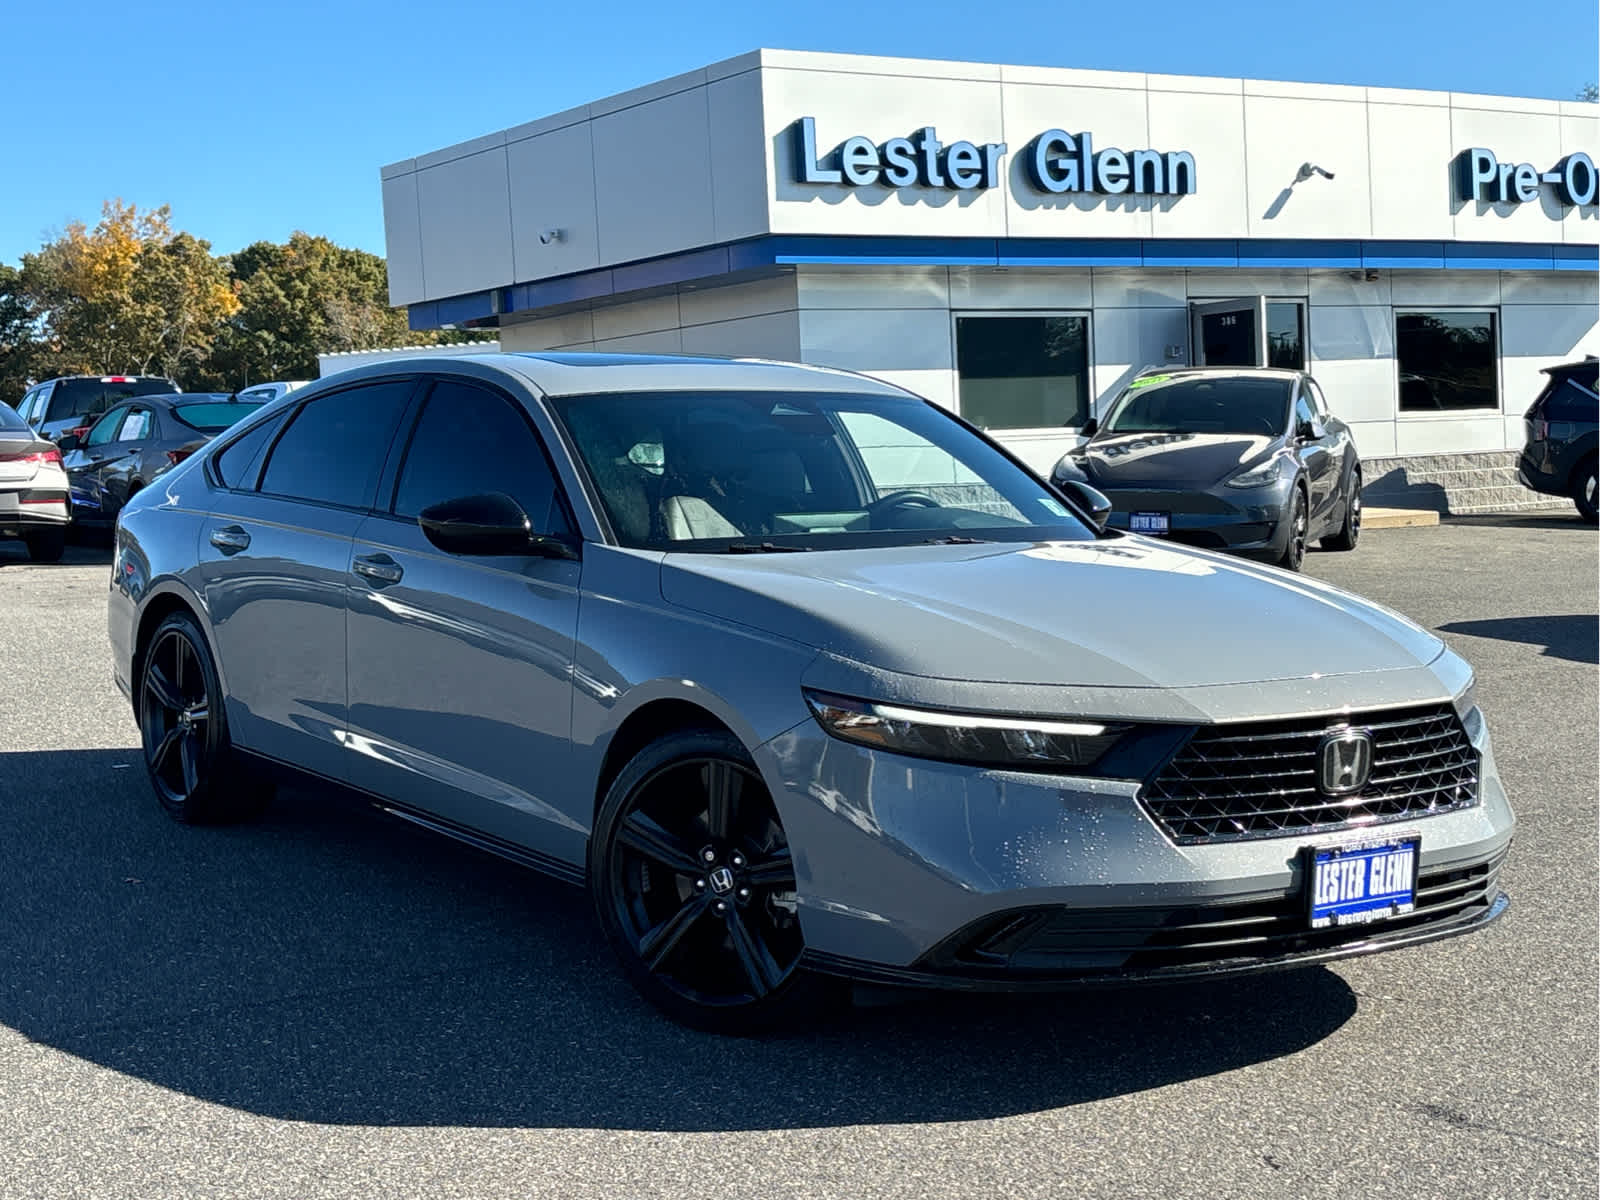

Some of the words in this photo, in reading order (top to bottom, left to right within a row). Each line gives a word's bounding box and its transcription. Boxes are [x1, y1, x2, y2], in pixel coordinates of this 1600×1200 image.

[799, 116, 1007, 190] Lester
[1031, 128, 1197, 195] Glenn
[1469, 147, 1599, 206] Pre-O
[1314, 859, 1366, 906] LESTER
[1369, 851, 1414, 896] GLENN
